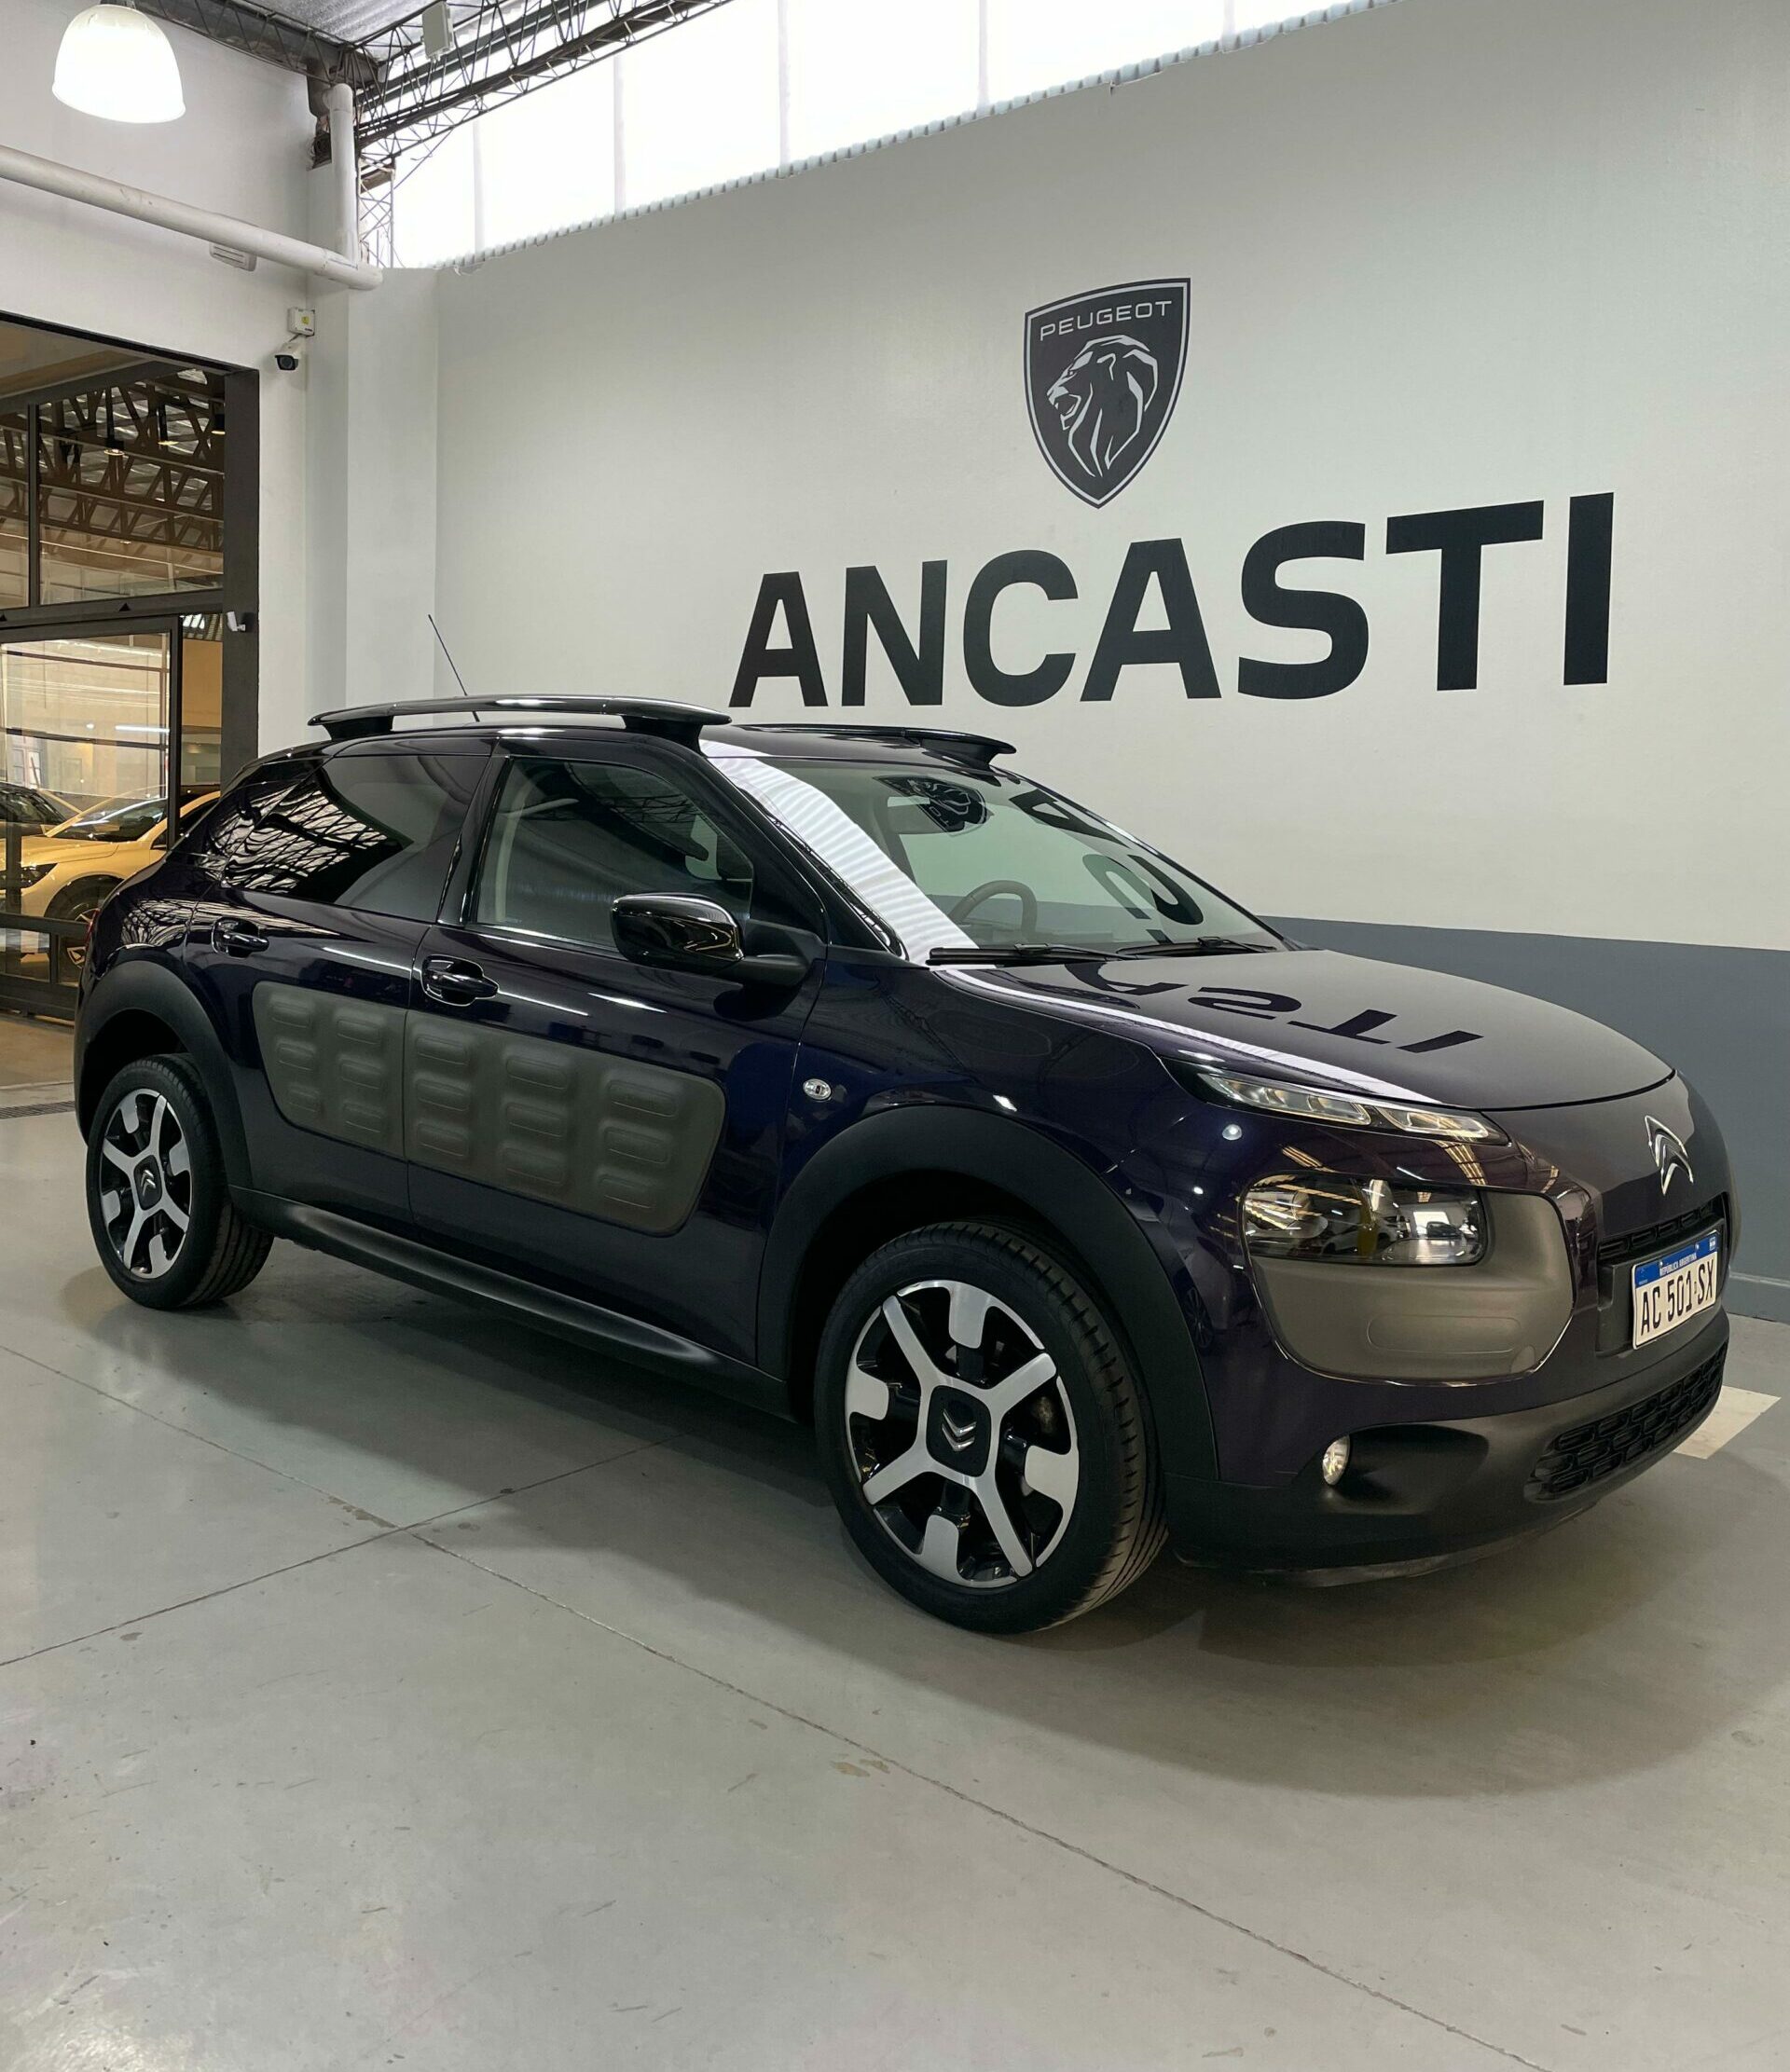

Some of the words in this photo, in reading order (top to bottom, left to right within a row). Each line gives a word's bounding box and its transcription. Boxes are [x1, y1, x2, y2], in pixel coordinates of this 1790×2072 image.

[1040, 299, 1173, 342] PEUGEOT
[729, 491, 1615, 708] ANCASTI
[1641, 1286, 1661, 1337] AC
[1667, 1270, 1693, 1323] 501
[1698, 1259, 1715, 1305] SX
